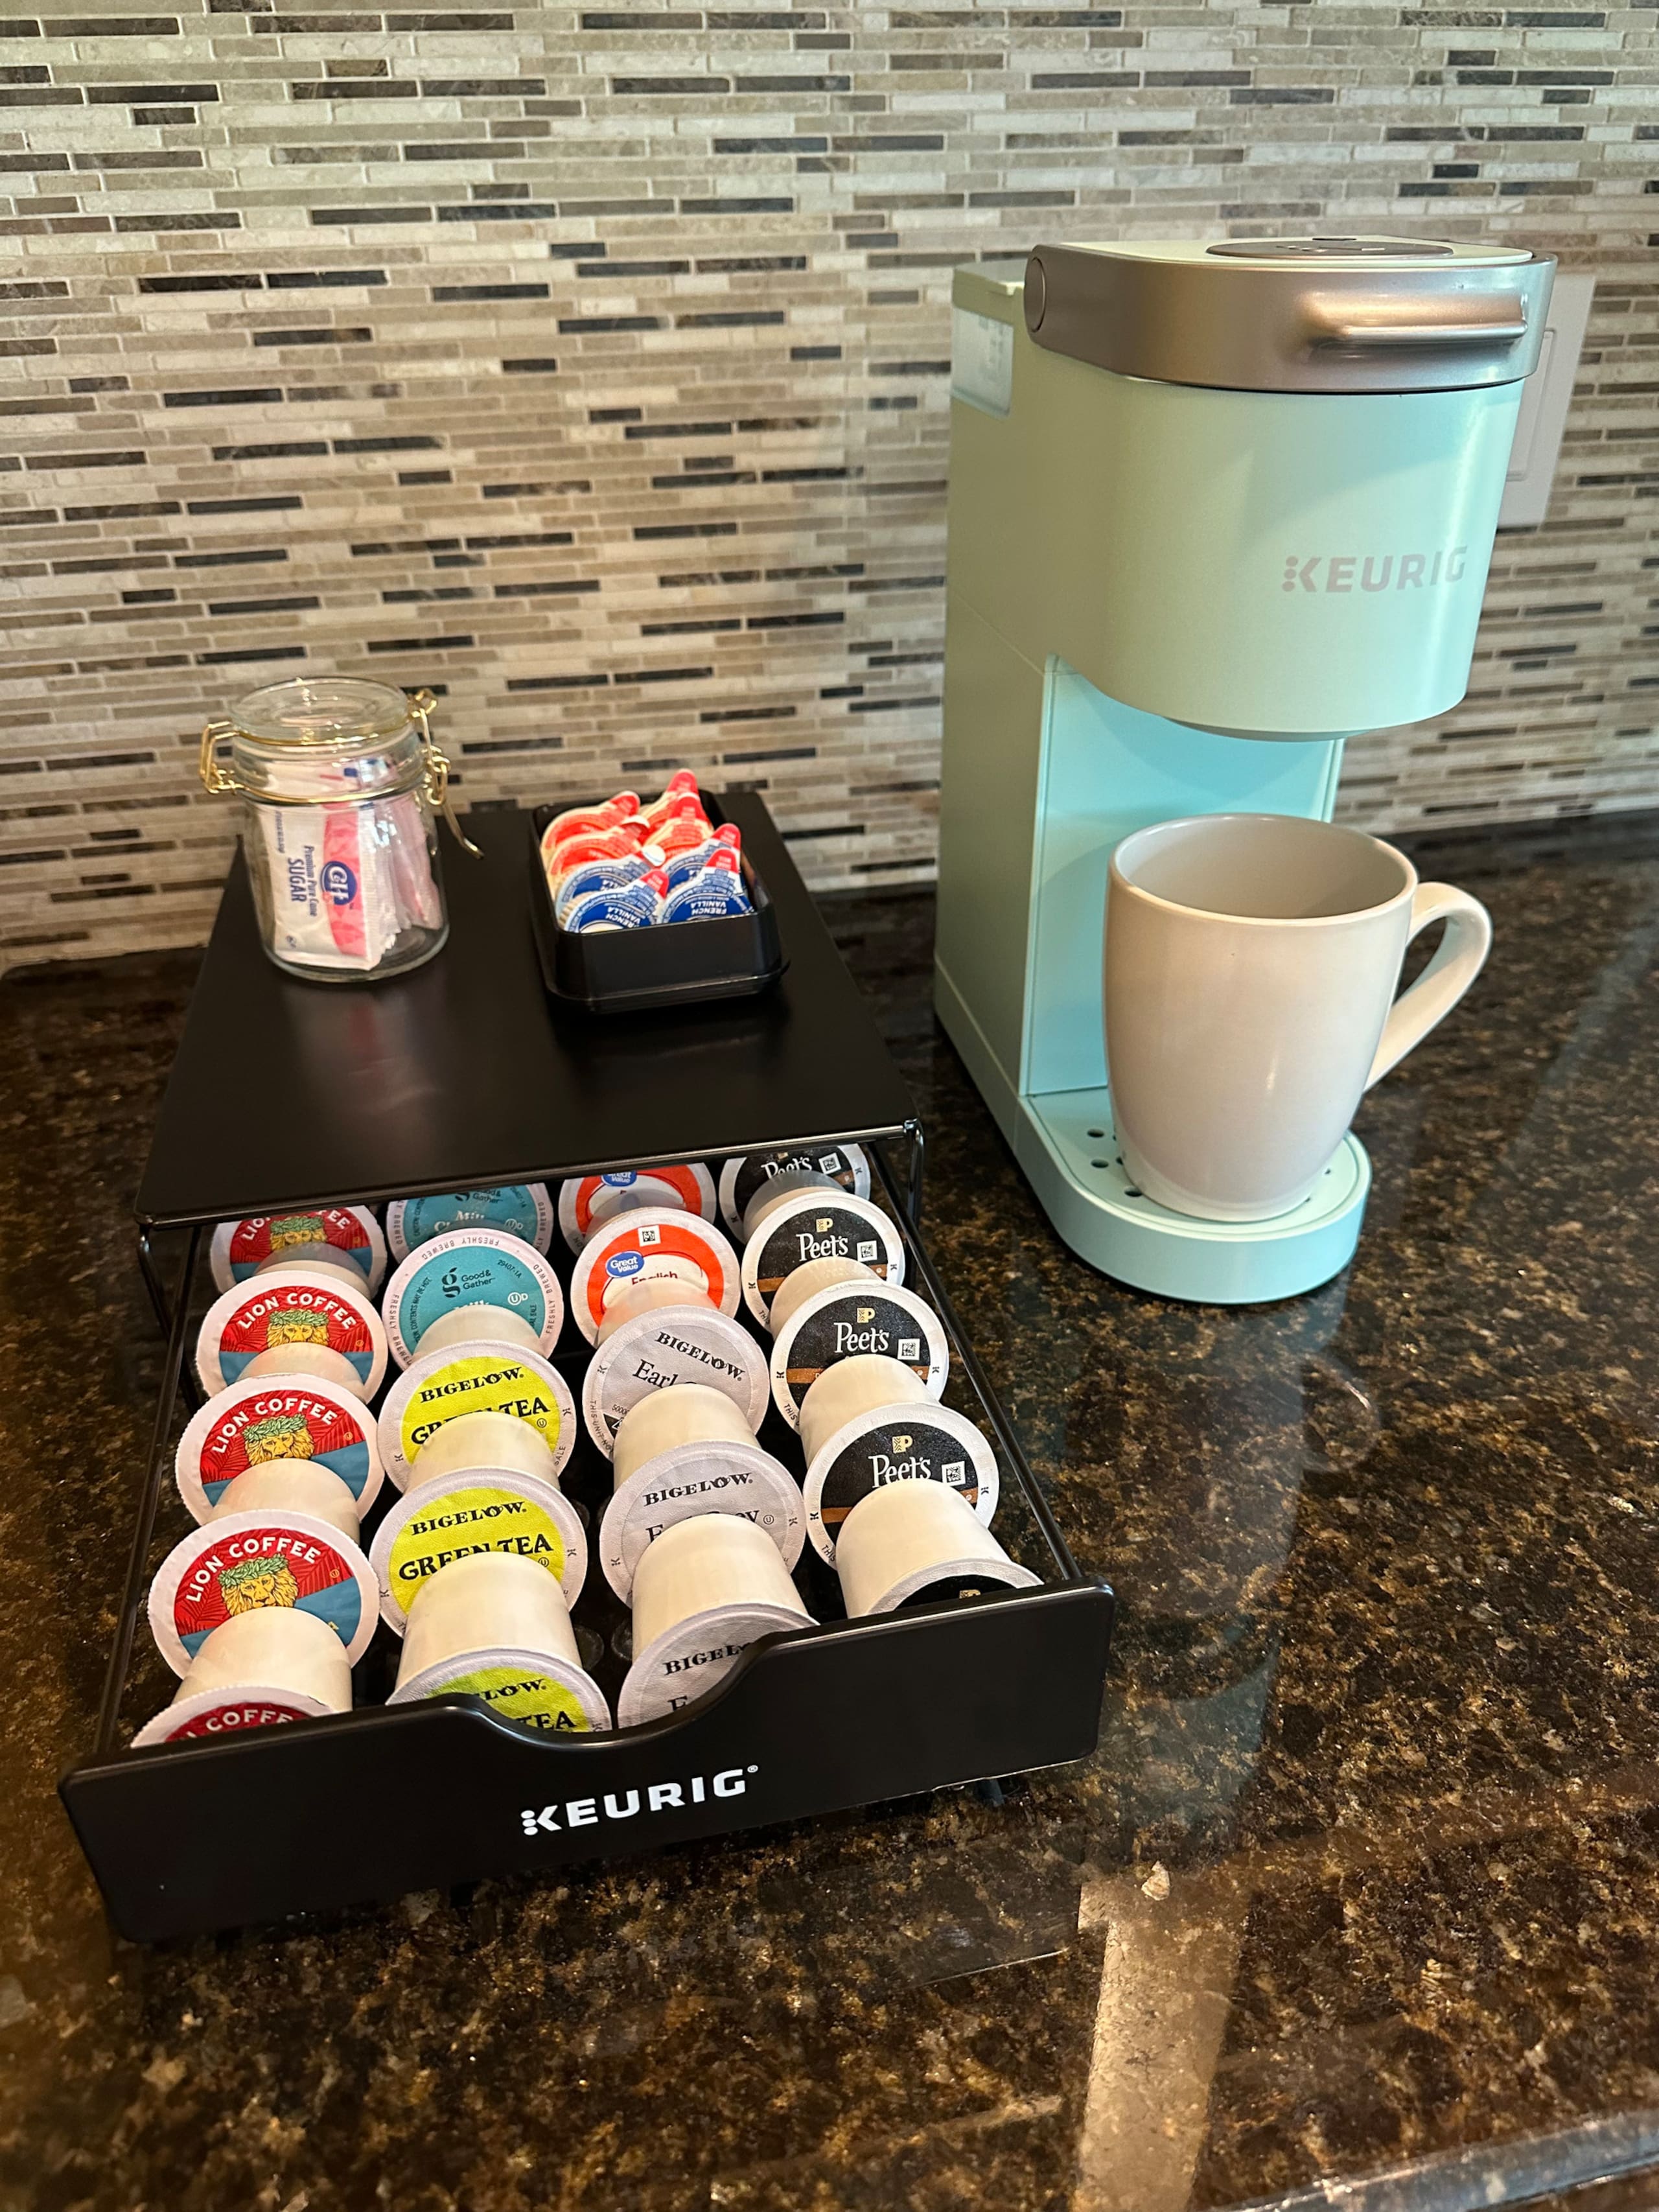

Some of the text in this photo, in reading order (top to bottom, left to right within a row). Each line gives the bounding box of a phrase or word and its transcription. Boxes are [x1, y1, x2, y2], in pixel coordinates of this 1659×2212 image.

[1282, 546, 1467, 592] KEURIG
[287, 857, 308, 902] SUGAR
[310, 898, 319, 916] Cane
[607, 907, 641, 925] VANILLA
[690, 900, 726, 909] VANILLA
[242, 1217, 270, 1240] LIO
[421, 1237, 500, 1260] FRESHLY BREWED
[610, 1255, 639, 1268] Great
[796, 1232, 849, 1262] Peet's
[462, 1277, 493, 1290] Gather
[533, 1264, 553, 1294] BREWED
[617, 1263, 639, 1274] Value
[237, 1292, 357, 1330] LION COFFEE
[389, 1294, 399, 1329] FRESHLY
[545, 1299, 556, 1334] FRESHLY
[833, 1321, 890, 1354] Peet's
[655, 1332, 746, 1381] BIGELOW
[419, 1367, 522, 1404] BIGELOW
[632, 1358, 679, 1388] Earl
[498, 1396, 551, 1418] TEA
[783, 1403, 798, 1421] THIS
[212, 1397, 338, 1454] LION COFFEE
[868, 1454, 931, 1488] Peet's
[643, 1472, 752, 1507] BIGELOW
[410, 1501, 526, 1536] BIGELOW
[497, 1533, 553, 1555] TEA
[821, 1544, 835, 1562] THIS
[186, 1536, 321, 1603] LION COFFEE
[662, 1642, 750, 1676] BIGEL
[520, 1768, 747, 1836] KEURIG
